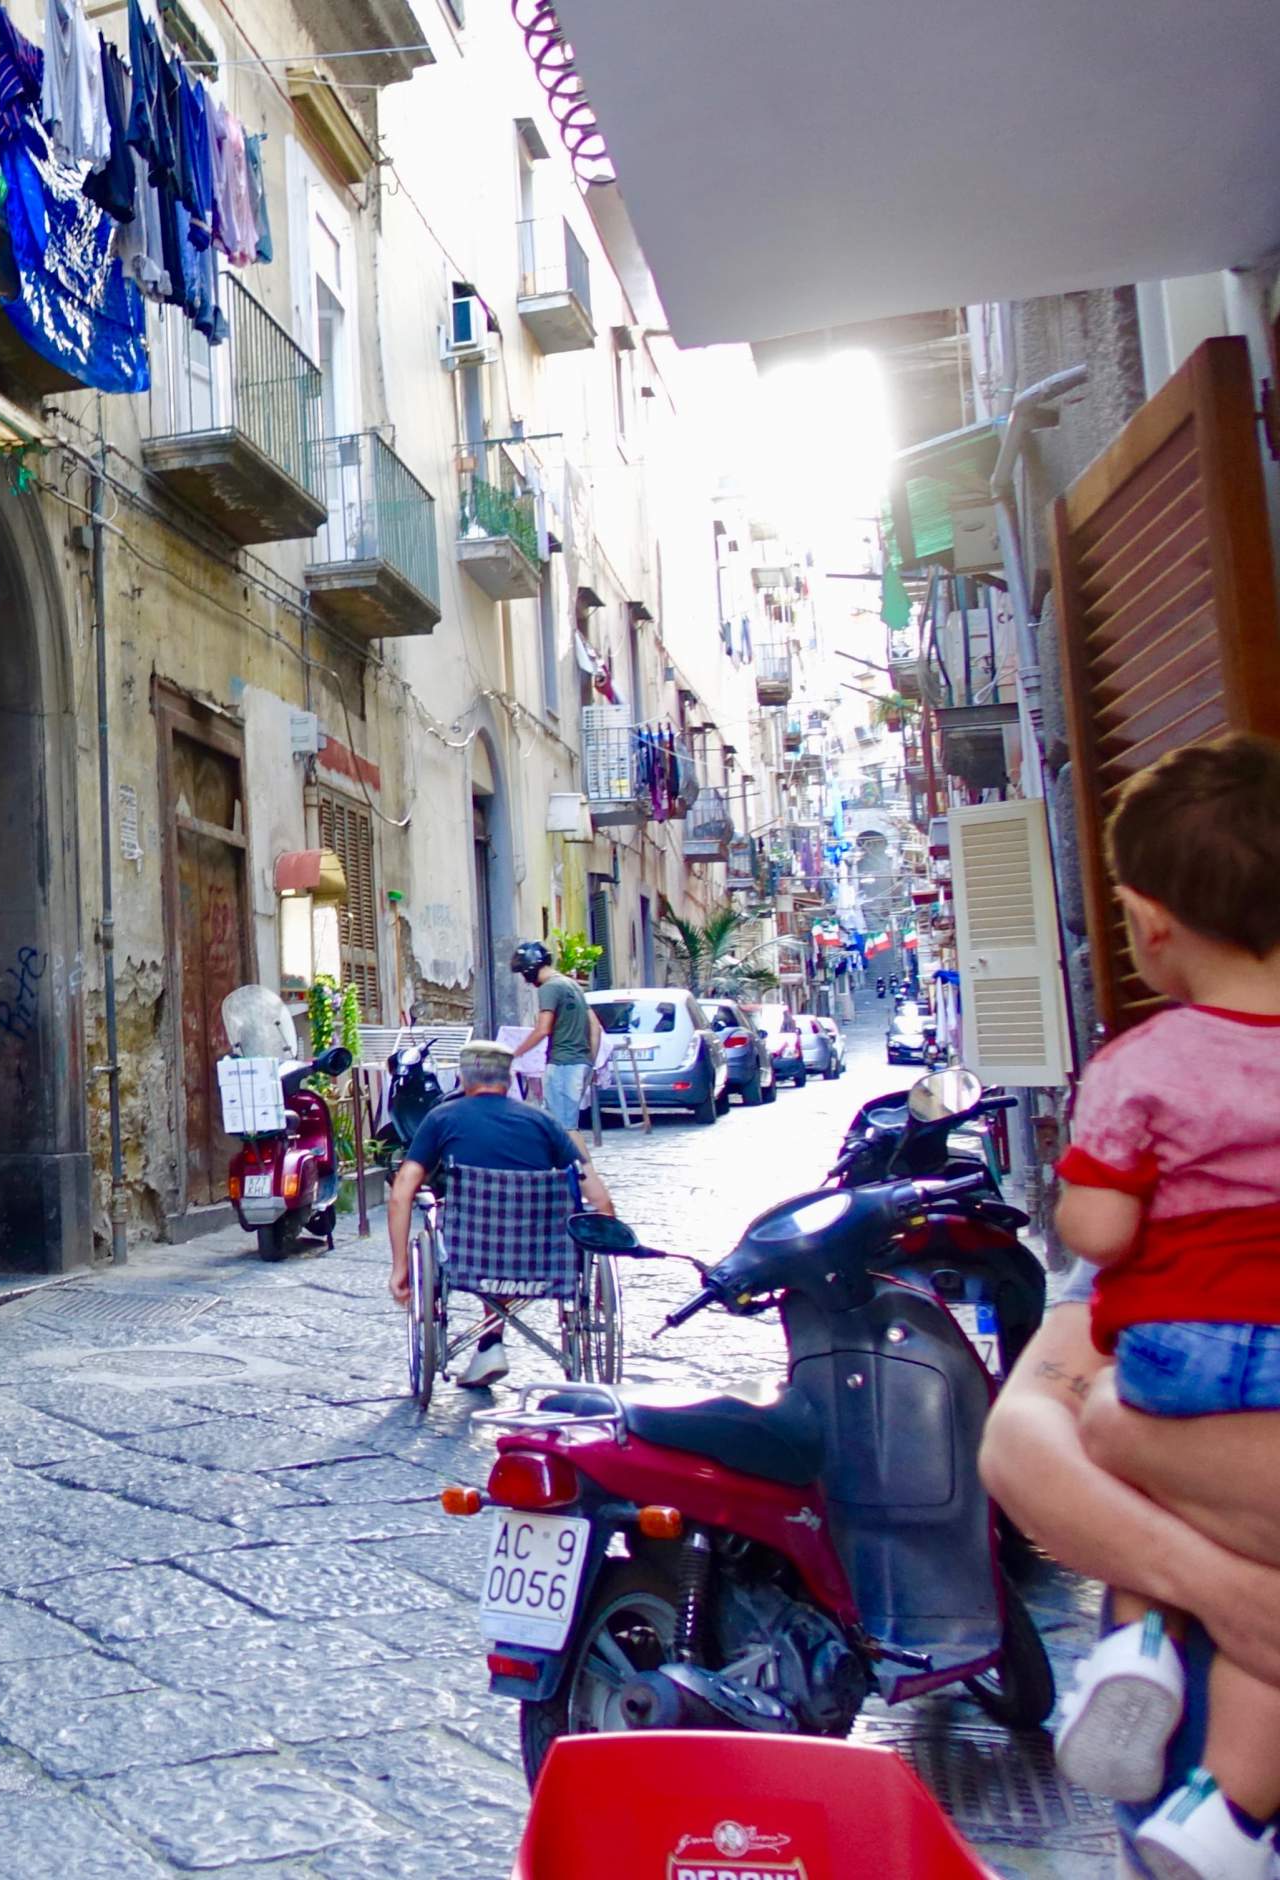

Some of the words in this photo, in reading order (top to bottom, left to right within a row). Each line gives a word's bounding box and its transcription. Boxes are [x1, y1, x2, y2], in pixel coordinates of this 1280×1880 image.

[494, 1521, 534, 1561] AC
[557, 1529, 577, 1566] 9
[487, 1565, 567, 1611] 0056
